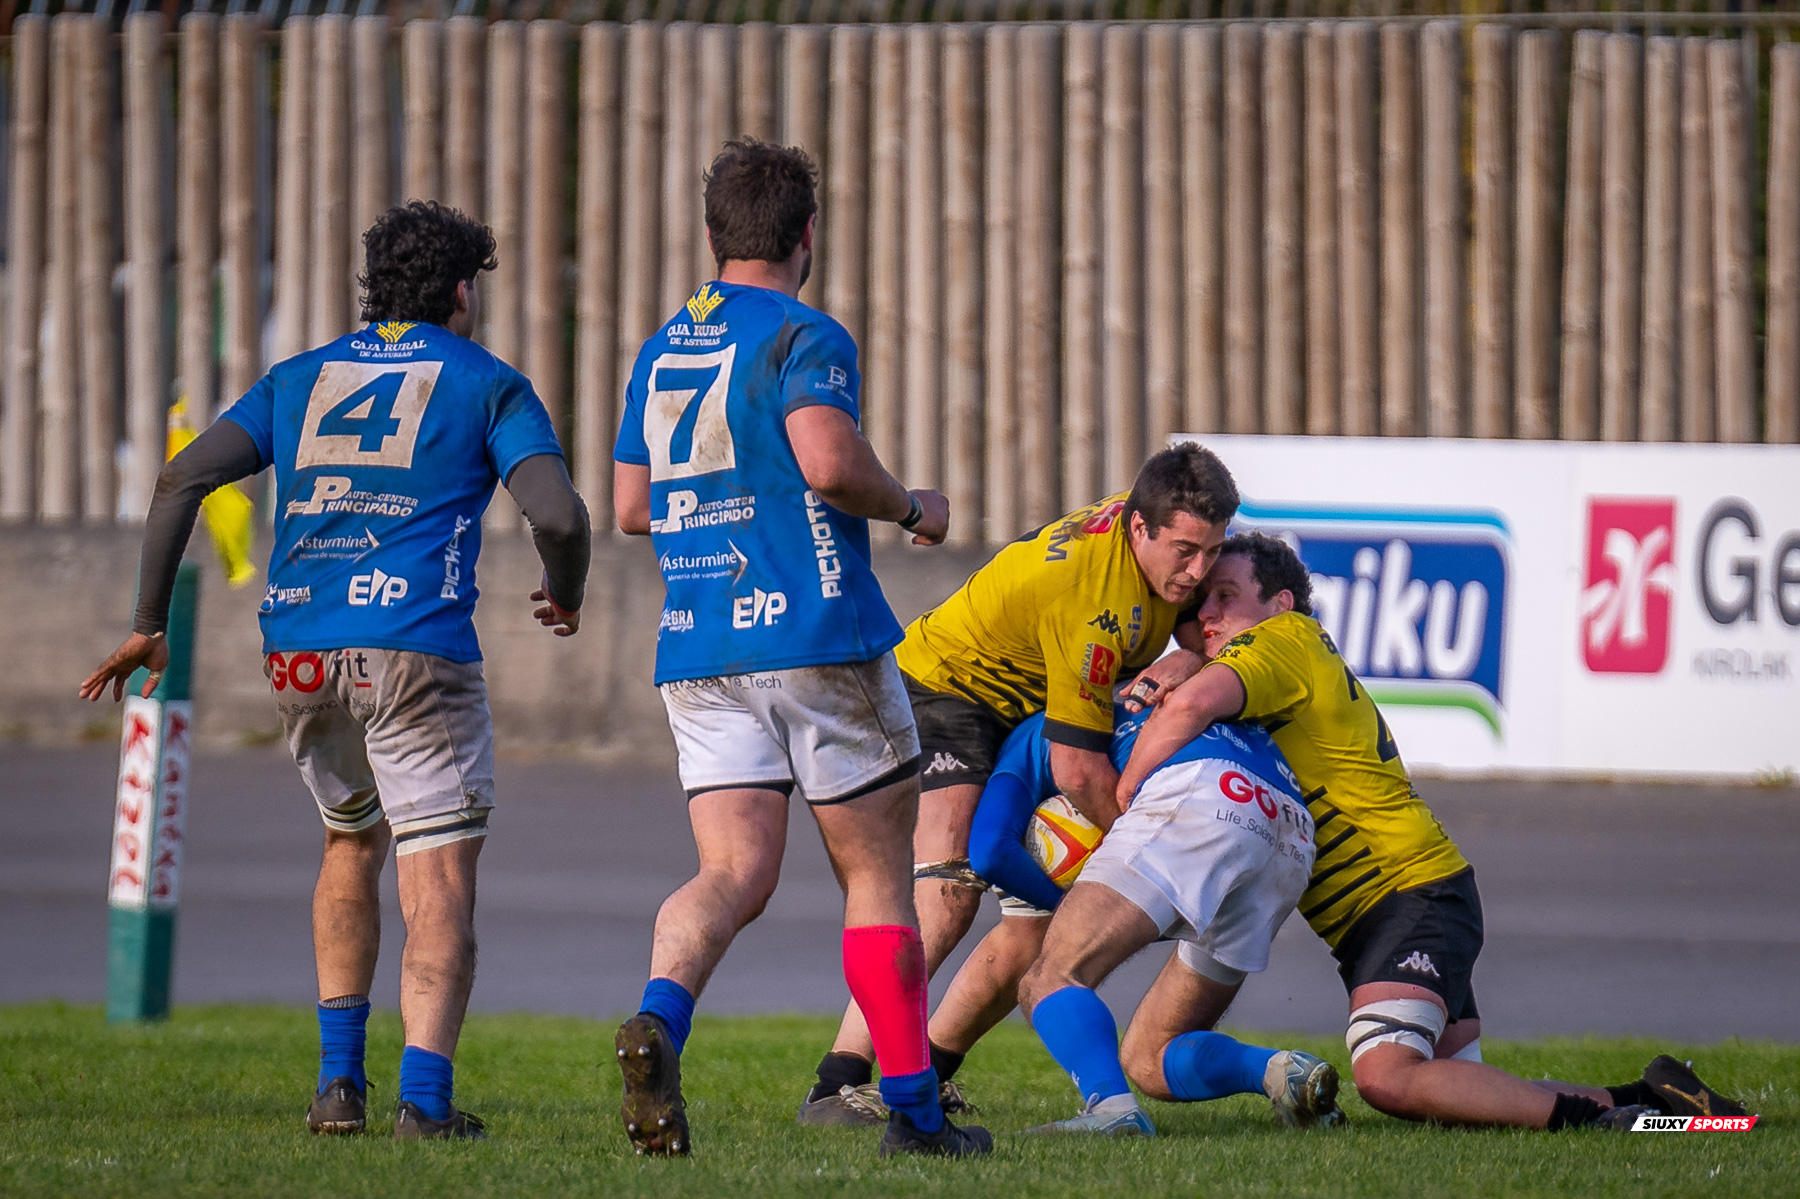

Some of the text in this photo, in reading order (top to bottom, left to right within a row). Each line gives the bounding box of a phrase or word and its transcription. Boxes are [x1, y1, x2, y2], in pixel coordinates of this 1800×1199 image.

[667, 322, 728, 337] CAJA RURAL
[350, 339, 427, 352] CAJA RURAL
[669, 337, 721, 347] DE ASTURIAS
[359, 350, 413, 359] DE ASTURIAS
[345, 490, 419, 507] AUTO-CENTER
[294, 535, 369, 549] Asturmine
[663, 551, 738, 572] Asturmine
[691, 571, 700, 579] de
[701, 569, 735, 579] vanguard
[1305, 537, 1490, 680] aiku
[268, 651, 325, 693] GO
[1219, 770, 1278, 819] GO
[1282, 802, 1309, 835] fit
